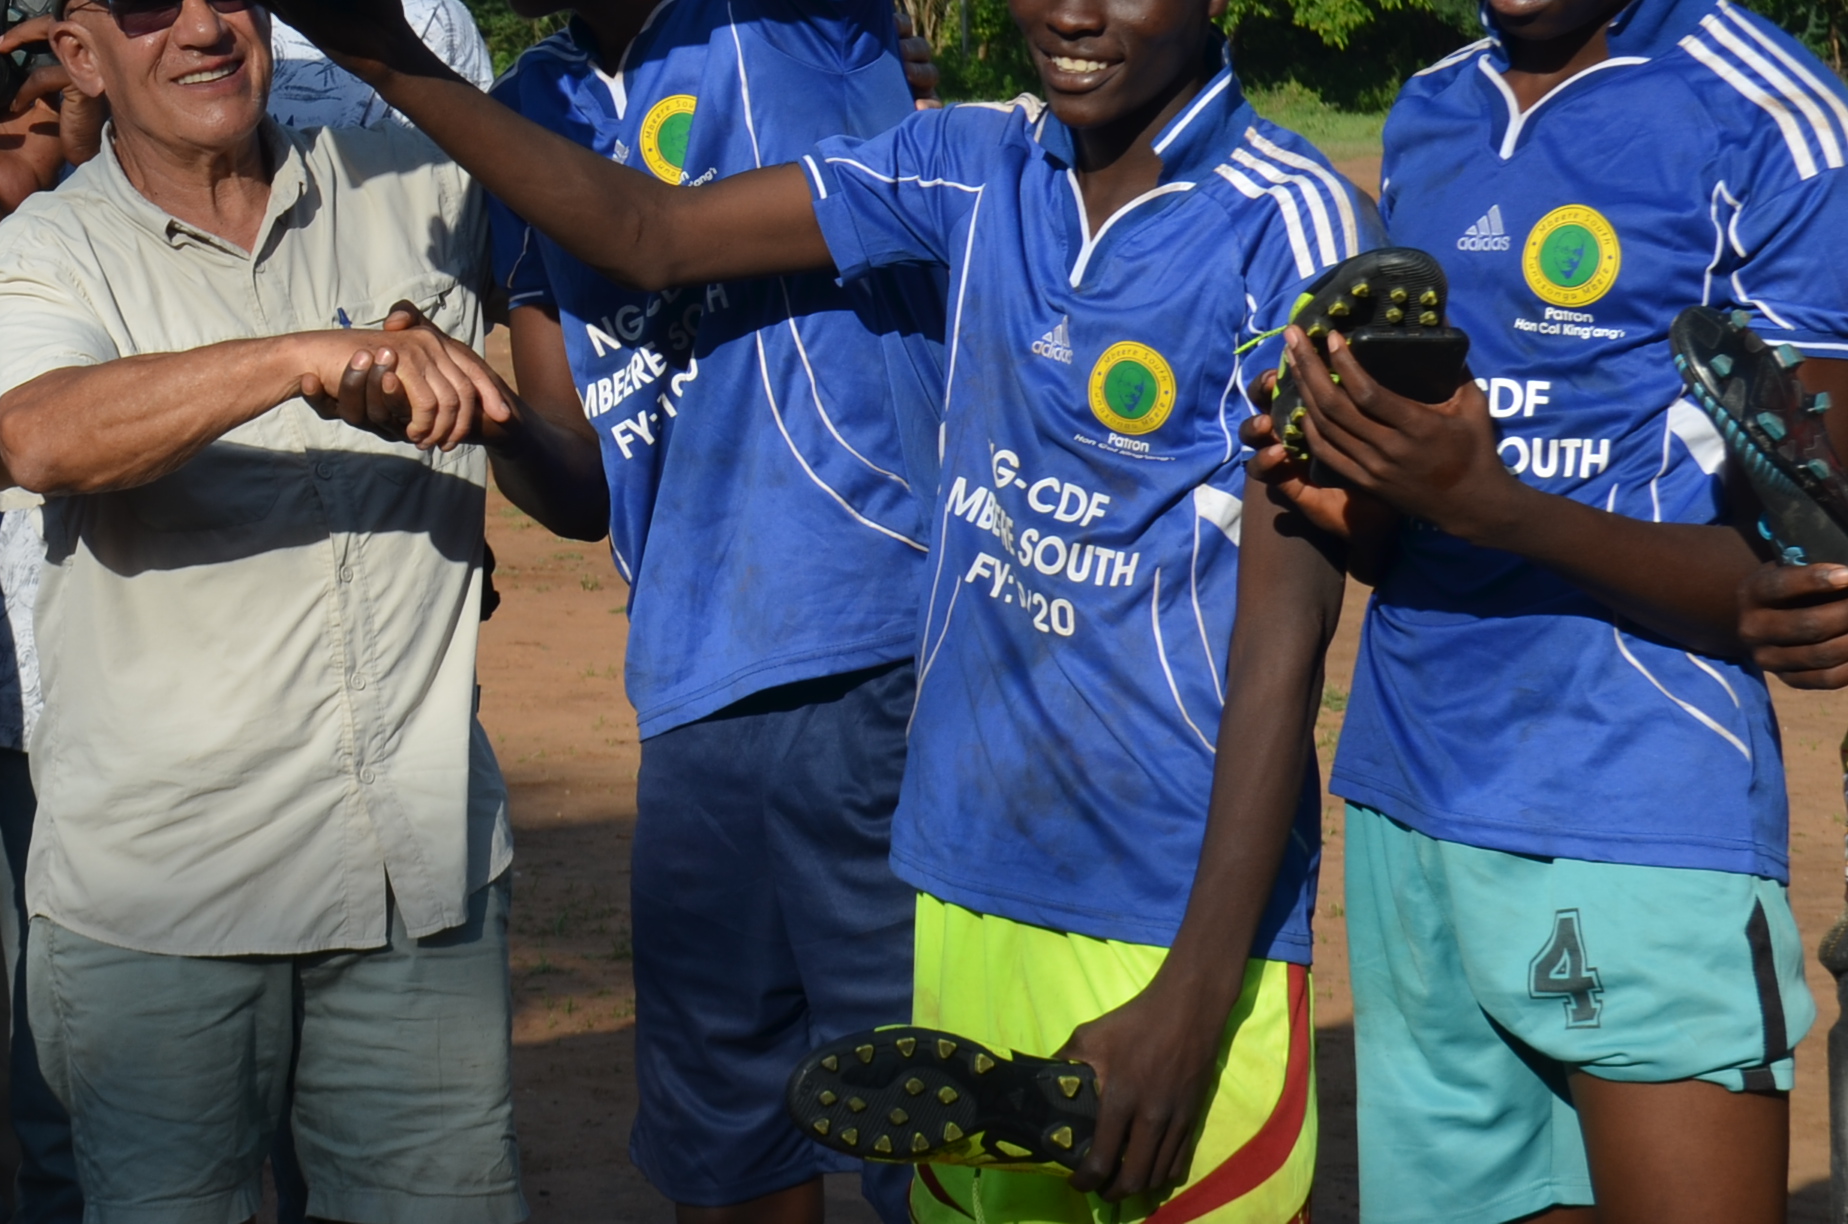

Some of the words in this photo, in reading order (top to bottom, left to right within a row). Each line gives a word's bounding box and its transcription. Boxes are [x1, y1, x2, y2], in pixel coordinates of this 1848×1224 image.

[1457, 234, 1510, 252] adidas
[1583, 214, 1611, 246] South
[1513, 317, 1538, 332] Hon
[1539, 321, 1561, 335] Col
[1544, 306, 1594, 324] Patron
[1073, 434, 1097, 446] Hon
[1107, 432, 1150, 453] Patron
[1495, 436, 1610, 479] OUTH
[988, 438, 1111, 527] G-CDF
[1017, 528, 1140, 587] SOUTH
[1527, 907, 1604, 1030] 4
